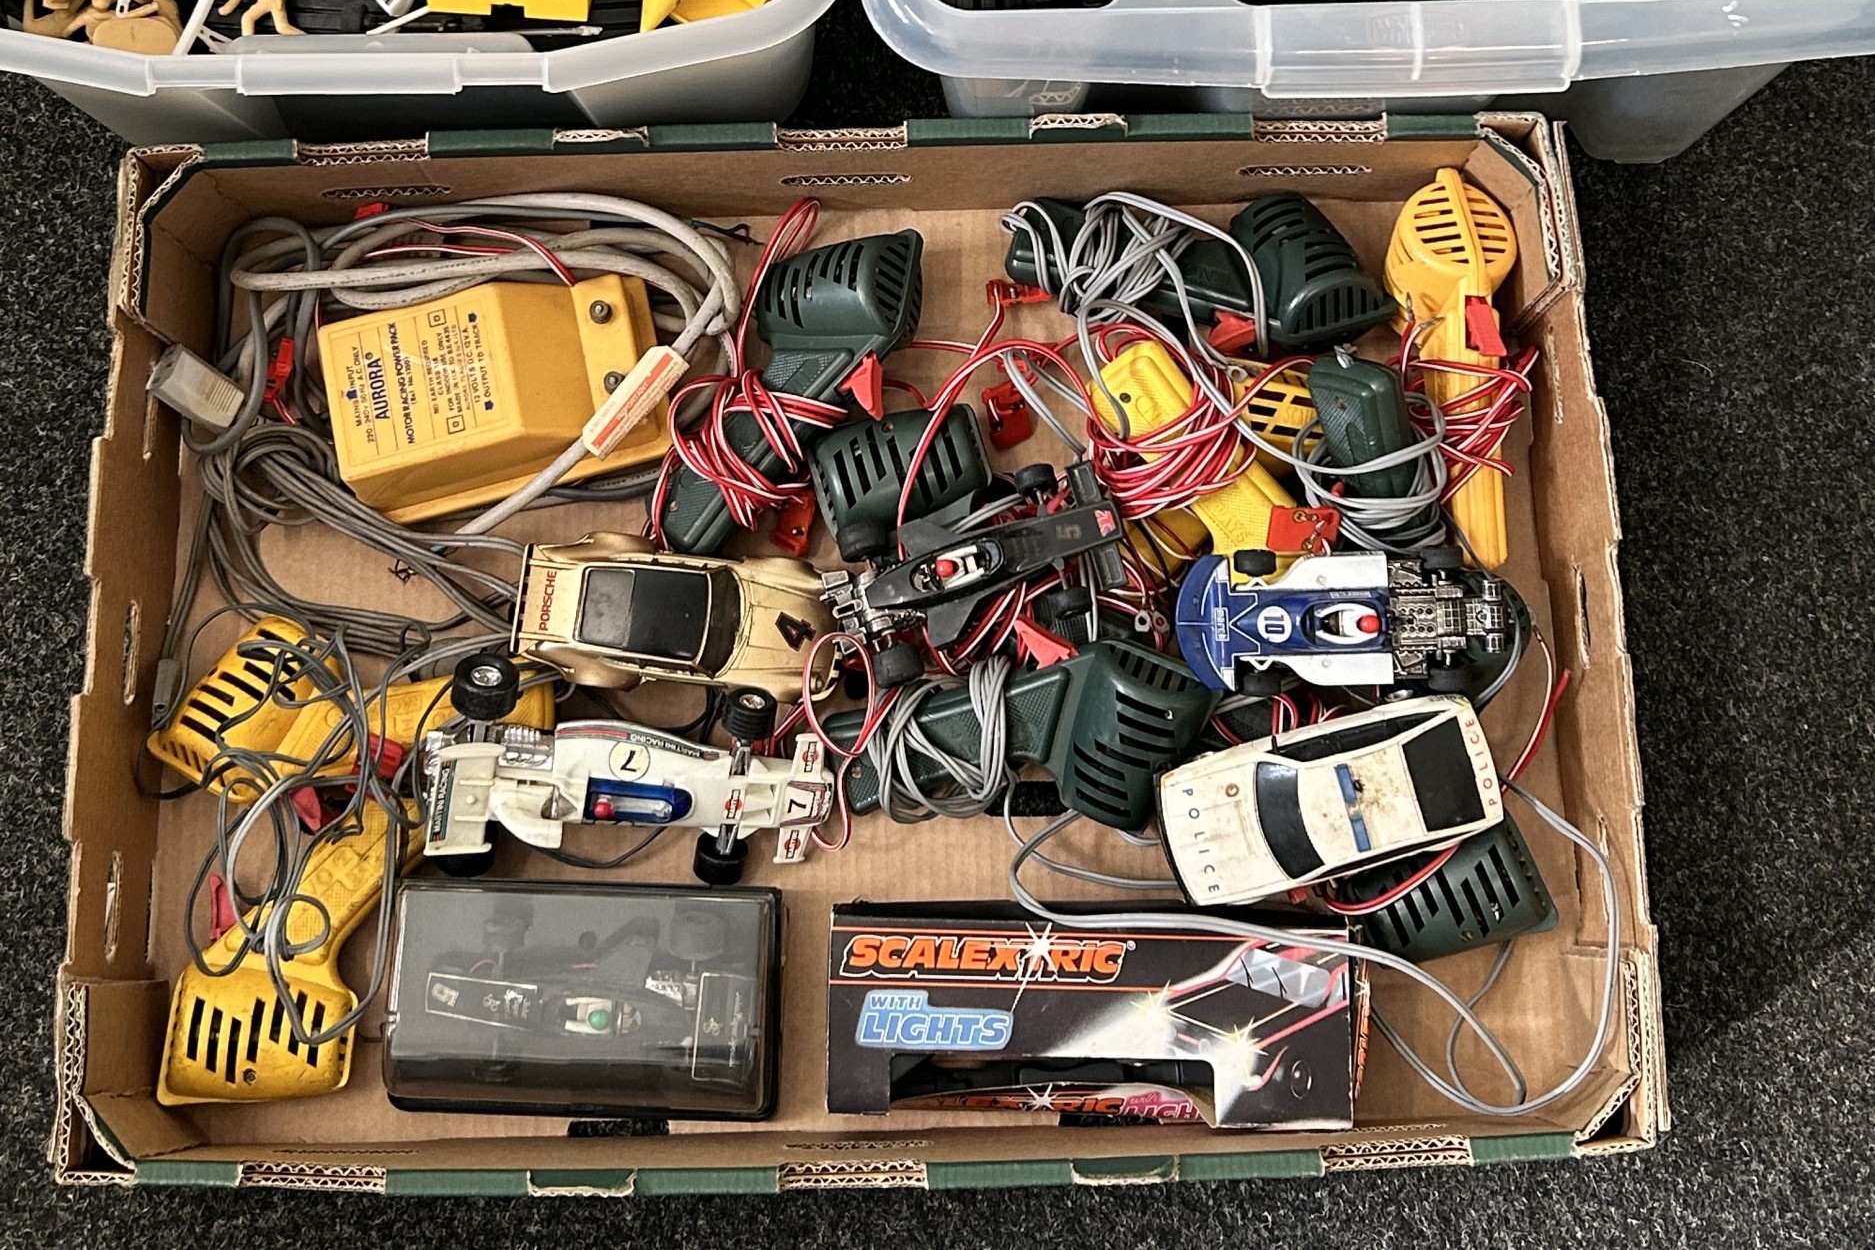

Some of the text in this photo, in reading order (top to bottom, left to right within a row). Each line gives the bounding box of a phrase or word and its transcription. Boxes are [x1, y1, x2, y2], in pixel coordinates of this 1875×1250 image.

[436, 332, 445, 351] ONLY
[351, 346, 361, 366] ONLY
[472, 323, 492, 398] OUTPUT TO TRACK
[387, 321, 416, 445] MOTOR RACING POWER PACK
[428, 377, 438, 402] EARTH
[435, 370, 444, 396] CLASS
[442, 368, 452, 395] INDOOR
[468, 367, 479, 393] VOLTS
[346, 366, 363, 427] MAINS INPUT
[447, 396, 455, 412] FOR
[454, 392, 463, 413] MADE
[473, 393, 481, 404] 12
[539, 570, 557, 631] PORSCHE
[775, 612, 816, 652] 4
[1263, 614, 1285, 634] 10
[620, 750, 638, 773] 7
[1464, 718, 1498, 806] POLICE
[432, 767, 450, 833] MARTINI RACING
[787, 798, 807, 814] 7
[1181, 788, 1220, 893] POLICE
[869, 995, 924, 1010] WITH
[859, 1013, 1011, 1046] LIGHTS
